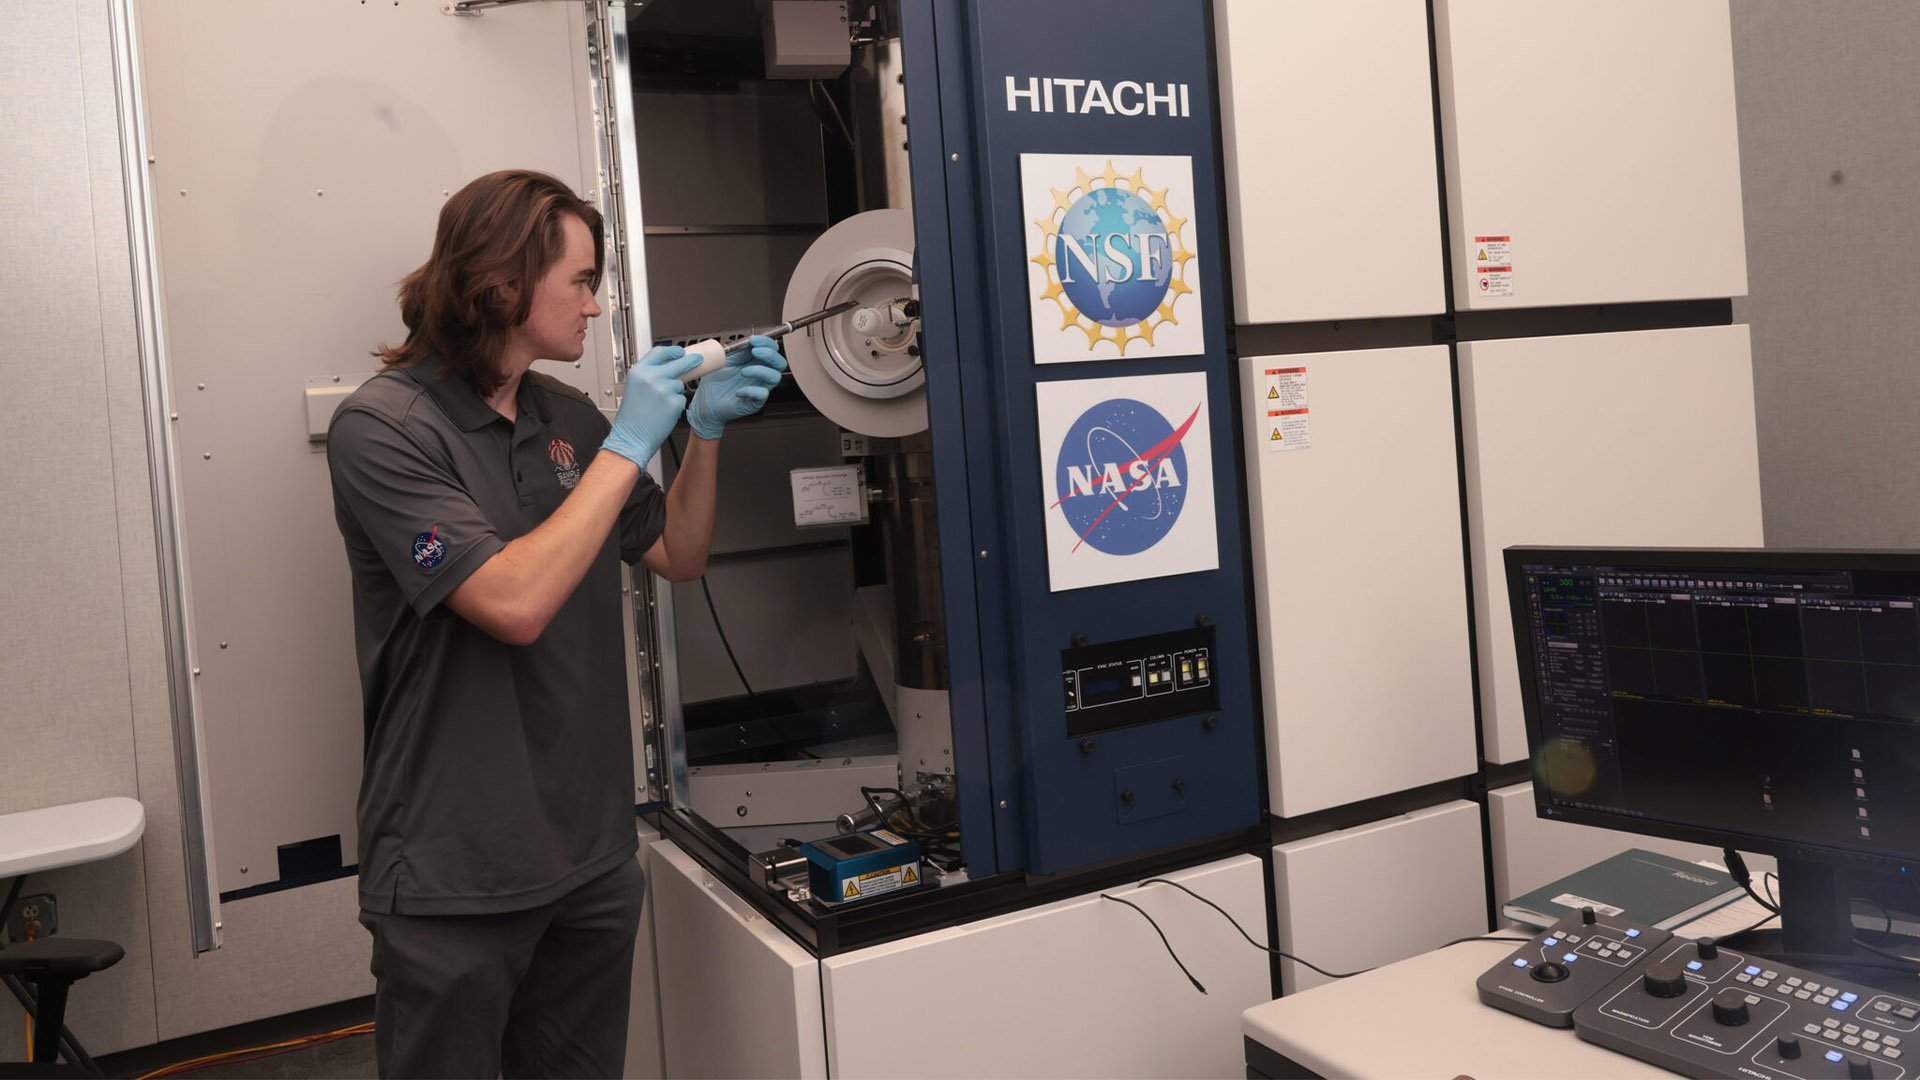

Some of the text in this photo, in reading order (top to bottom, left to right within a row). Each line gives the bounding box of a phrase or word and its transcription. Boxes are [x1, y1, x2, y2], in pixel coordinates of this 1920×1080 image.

[1005, 75, 1190, 118] HITACHI
[1057, 232, 1170, 284] NSF
[1067, 457, 1182, 498] NASA
[414, 539, 443, 564] NASA
[1559, 578, 1574, 587] 300
[1108, 660, 1123, 668] STATUS
[1671, 871, 1719, 887] Record
[1498, 985, 1545, 1003] STAGE CONTROLLER
[1611, 1008, 1651, 1024] MAGNIFICATION
[1875, 1016, 1896, 1026] RESET
[1687, 1032, 1723, 1048] BRIGHTNESS
[1737, 1066, 1773, 1080] HITACHI
